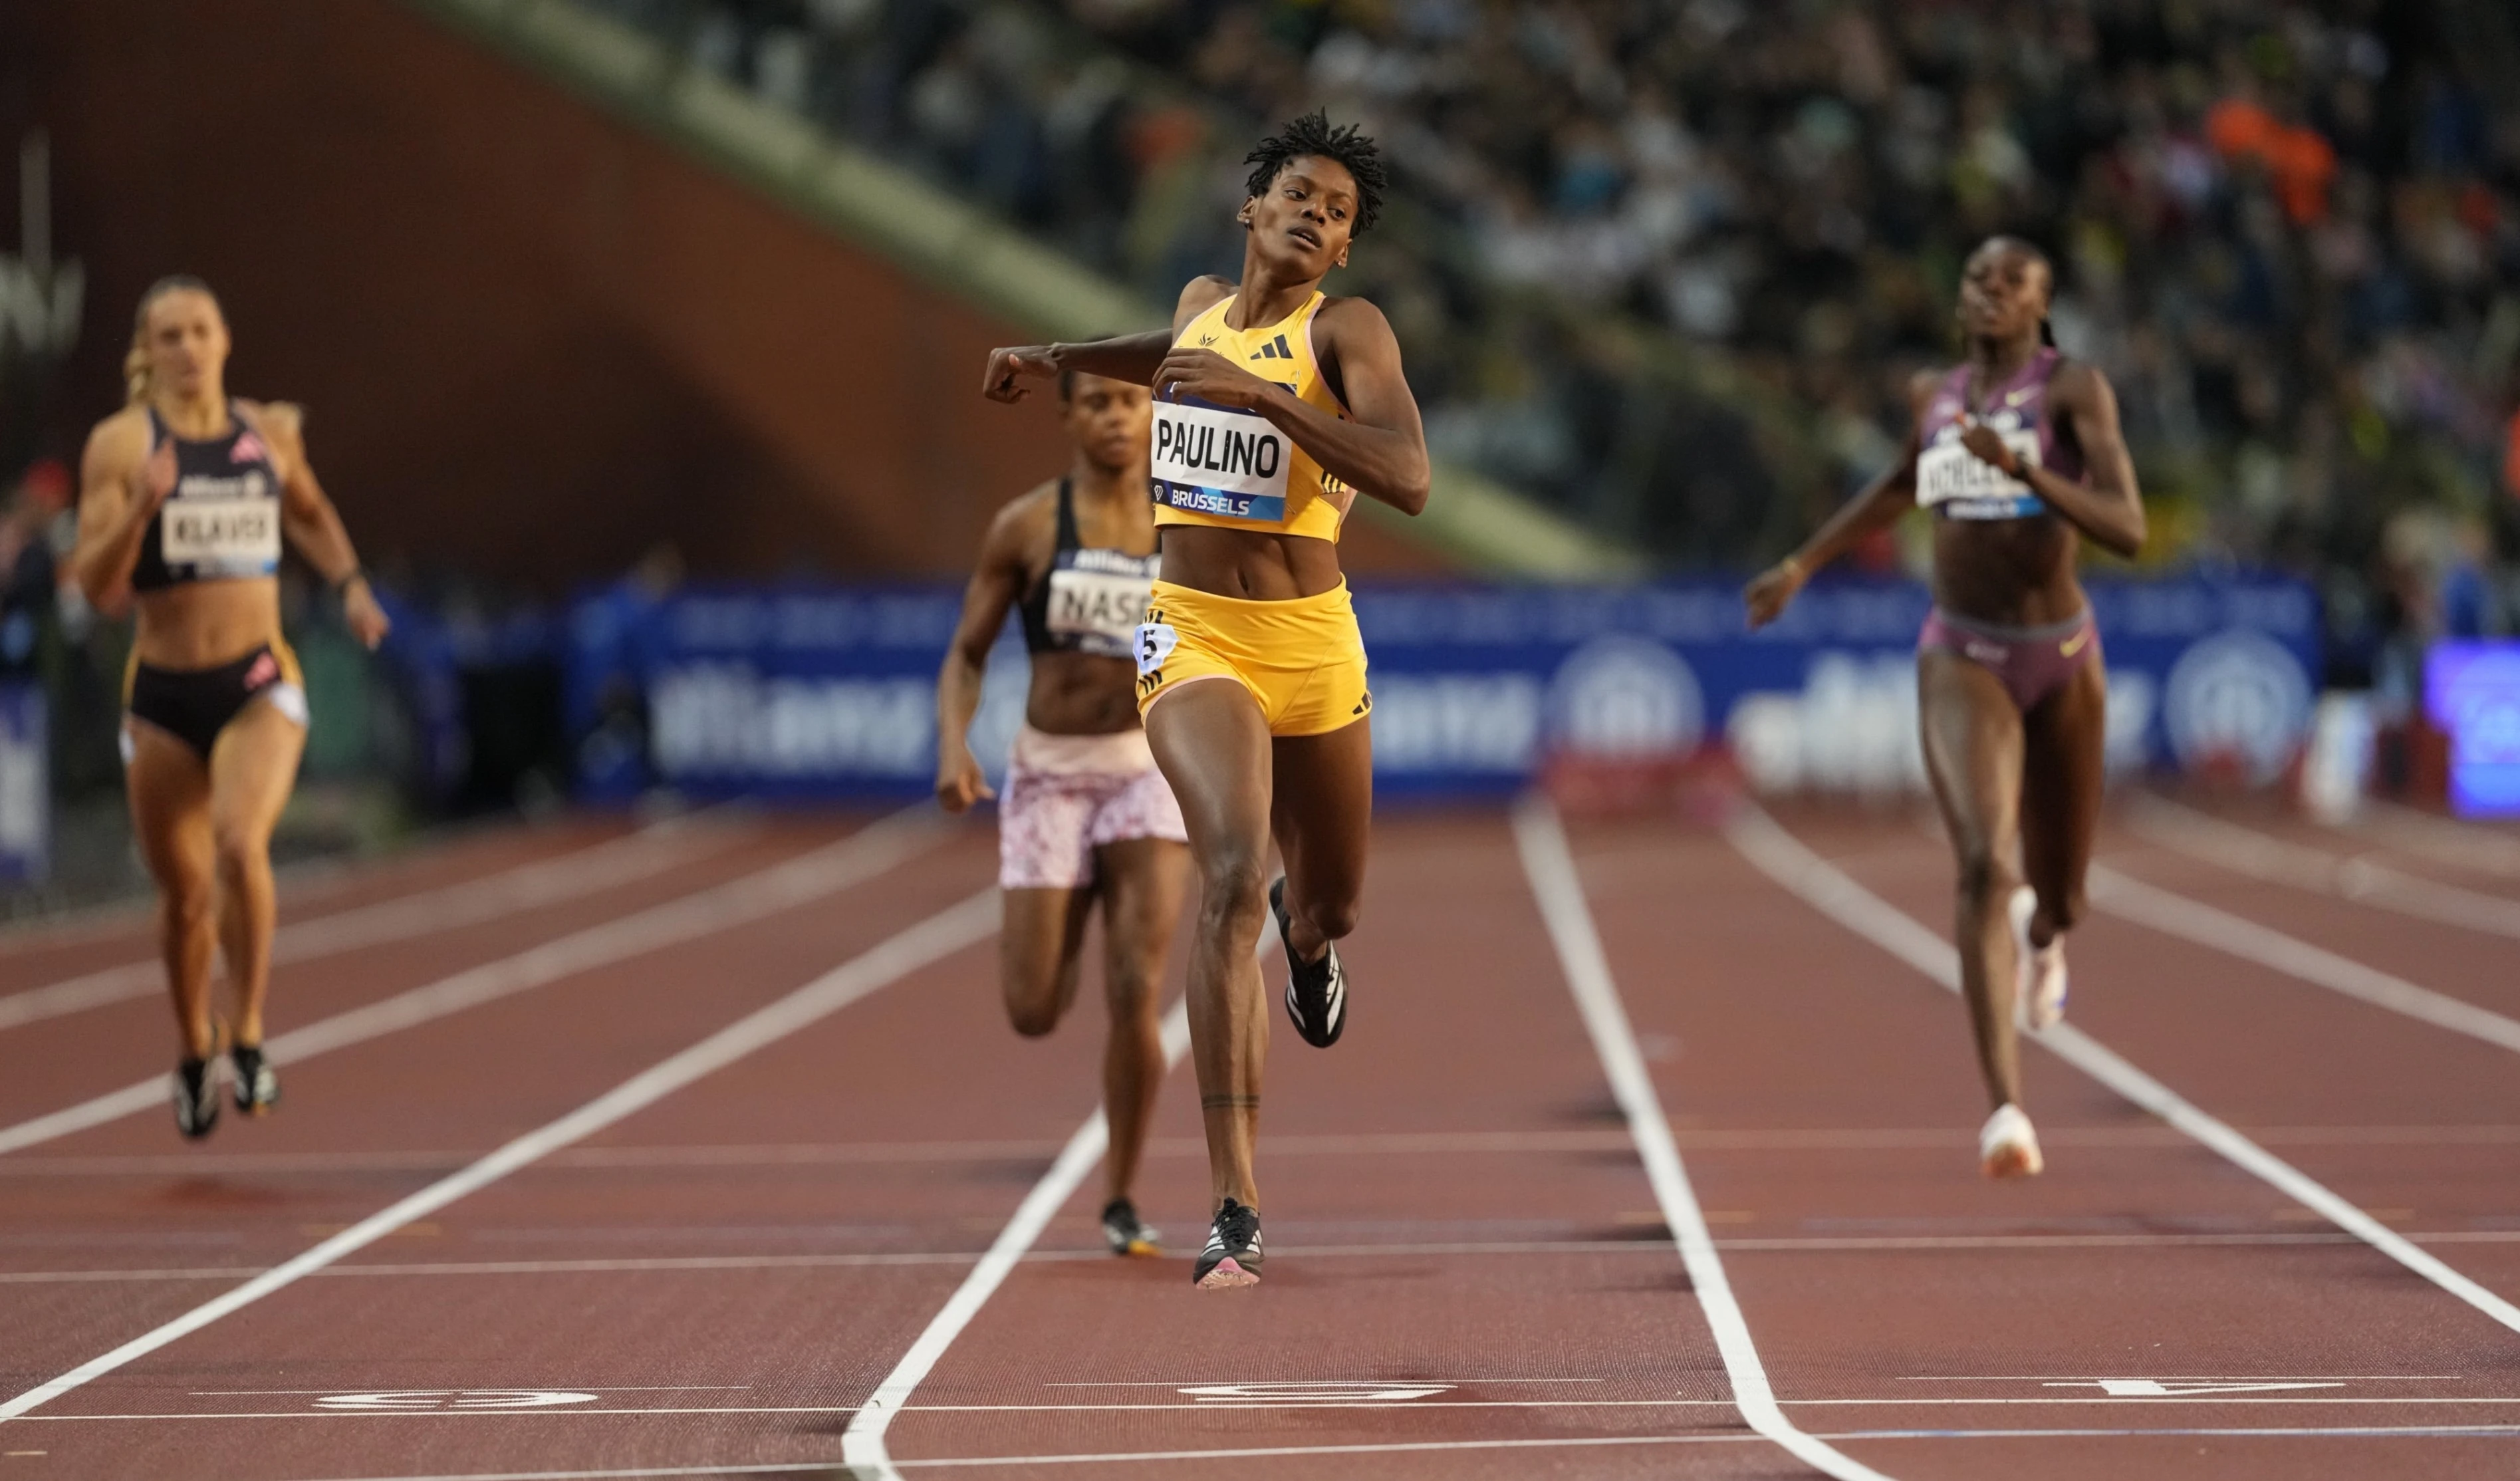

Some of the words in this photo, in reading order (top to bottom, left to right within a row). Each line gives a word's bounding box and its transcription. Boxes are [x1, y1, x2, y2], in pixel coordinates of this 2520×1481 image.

[1157, 419, 1280, 479] PAULINO
[1172, 489, 1249, 516] BRUSSELS
[1143, 629, 1158, 662] 5
